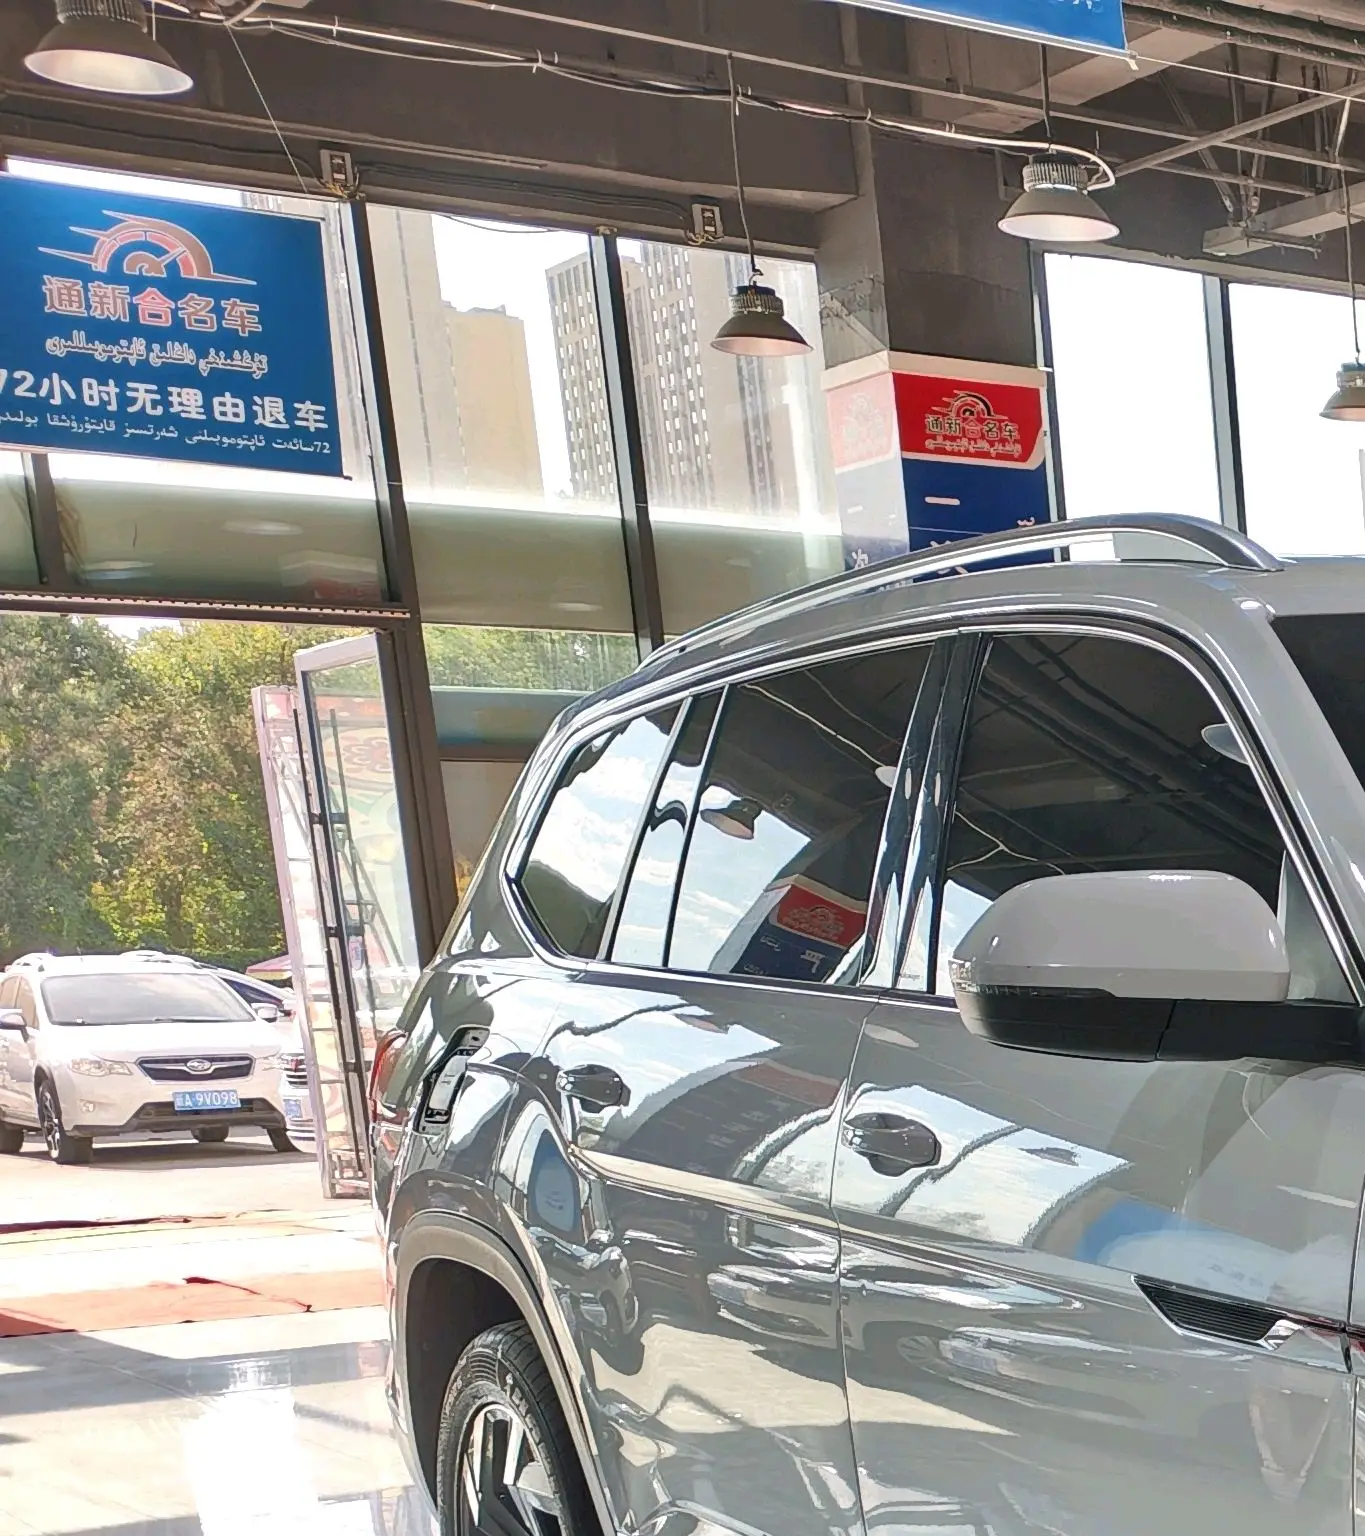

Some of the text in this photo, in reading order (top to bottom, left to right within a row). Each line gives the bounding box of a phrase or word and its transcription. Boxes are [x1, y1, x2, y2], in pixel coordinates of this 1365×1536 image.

[42, 275, 262, 337] 通新合名车
[925, 414, 1020, 440] 通新合名车
